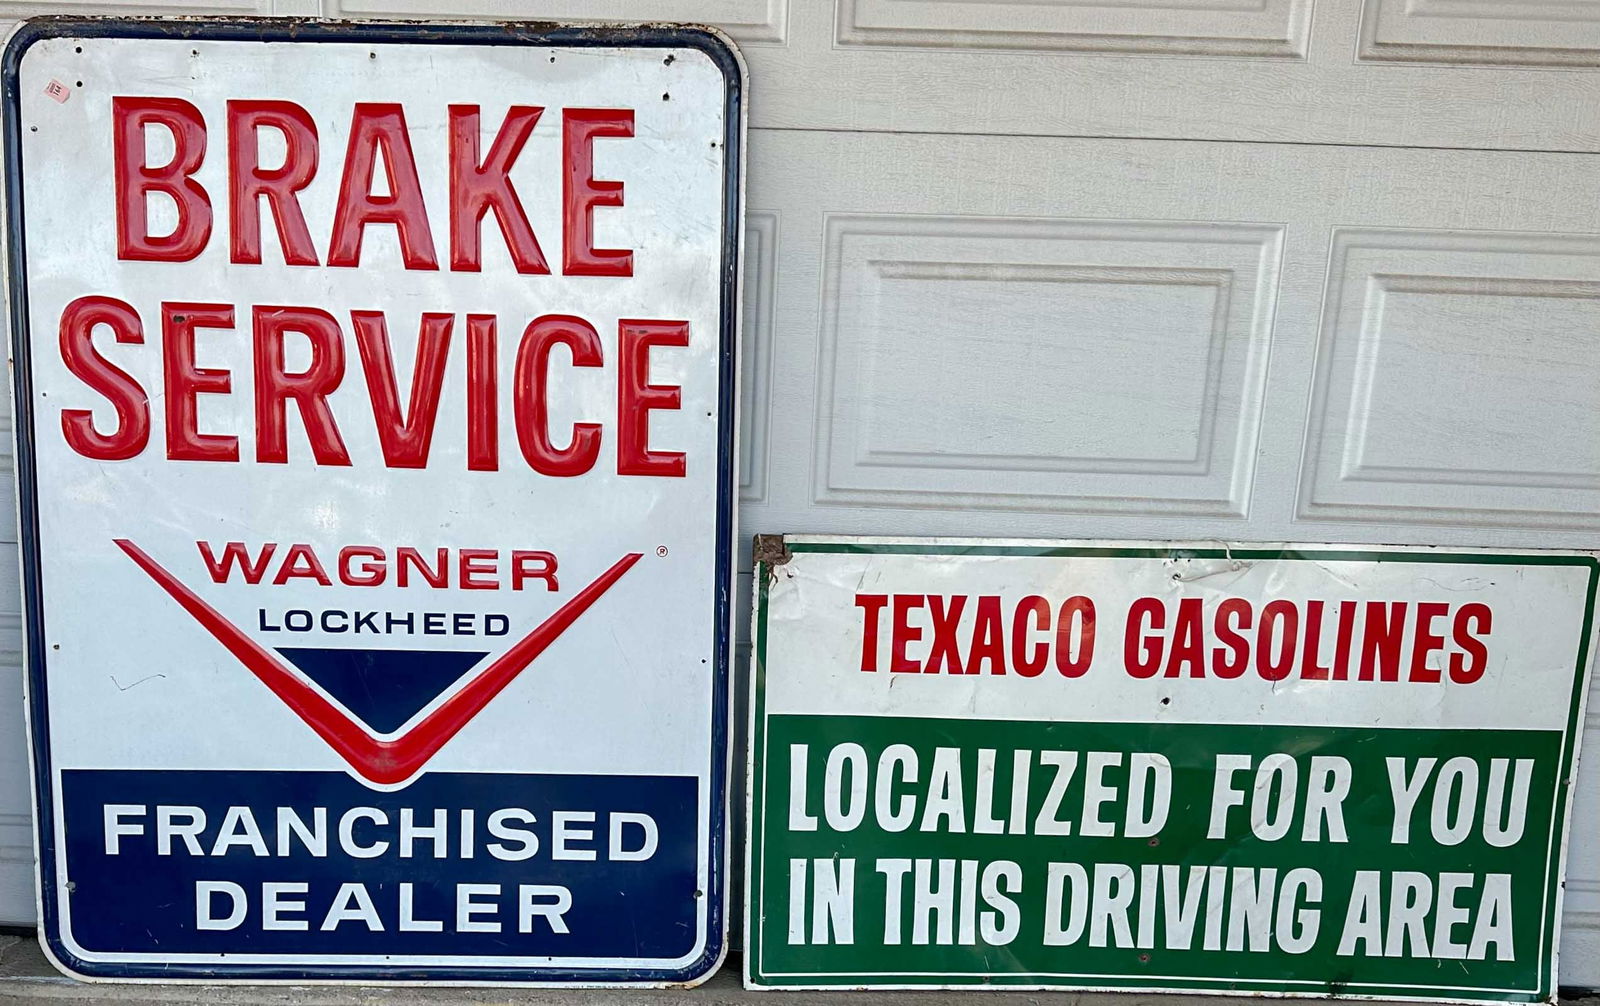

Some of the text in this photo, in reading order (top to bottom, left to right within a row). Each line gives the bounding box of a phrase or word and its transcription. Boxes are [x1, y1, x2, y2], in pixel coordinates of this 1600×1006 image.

[113, 96, 635, 277] BRAKE
[59, 296, 690, 477] SERVICE
[197, 541, 560, 592] WAGNER
[259, 608, 510, 637] LOCKHEED
[855, 595, 1492, 684] TEXACO GASOLINES
[103, 804, 659, 862] FRANCHISED
[789, 743, 1535, 848] LOCALIZED FOR YOU
[196, 881, 573, 934] DEALER
[788, 858, 1515, 962] IN THIS DRIVING AREA
